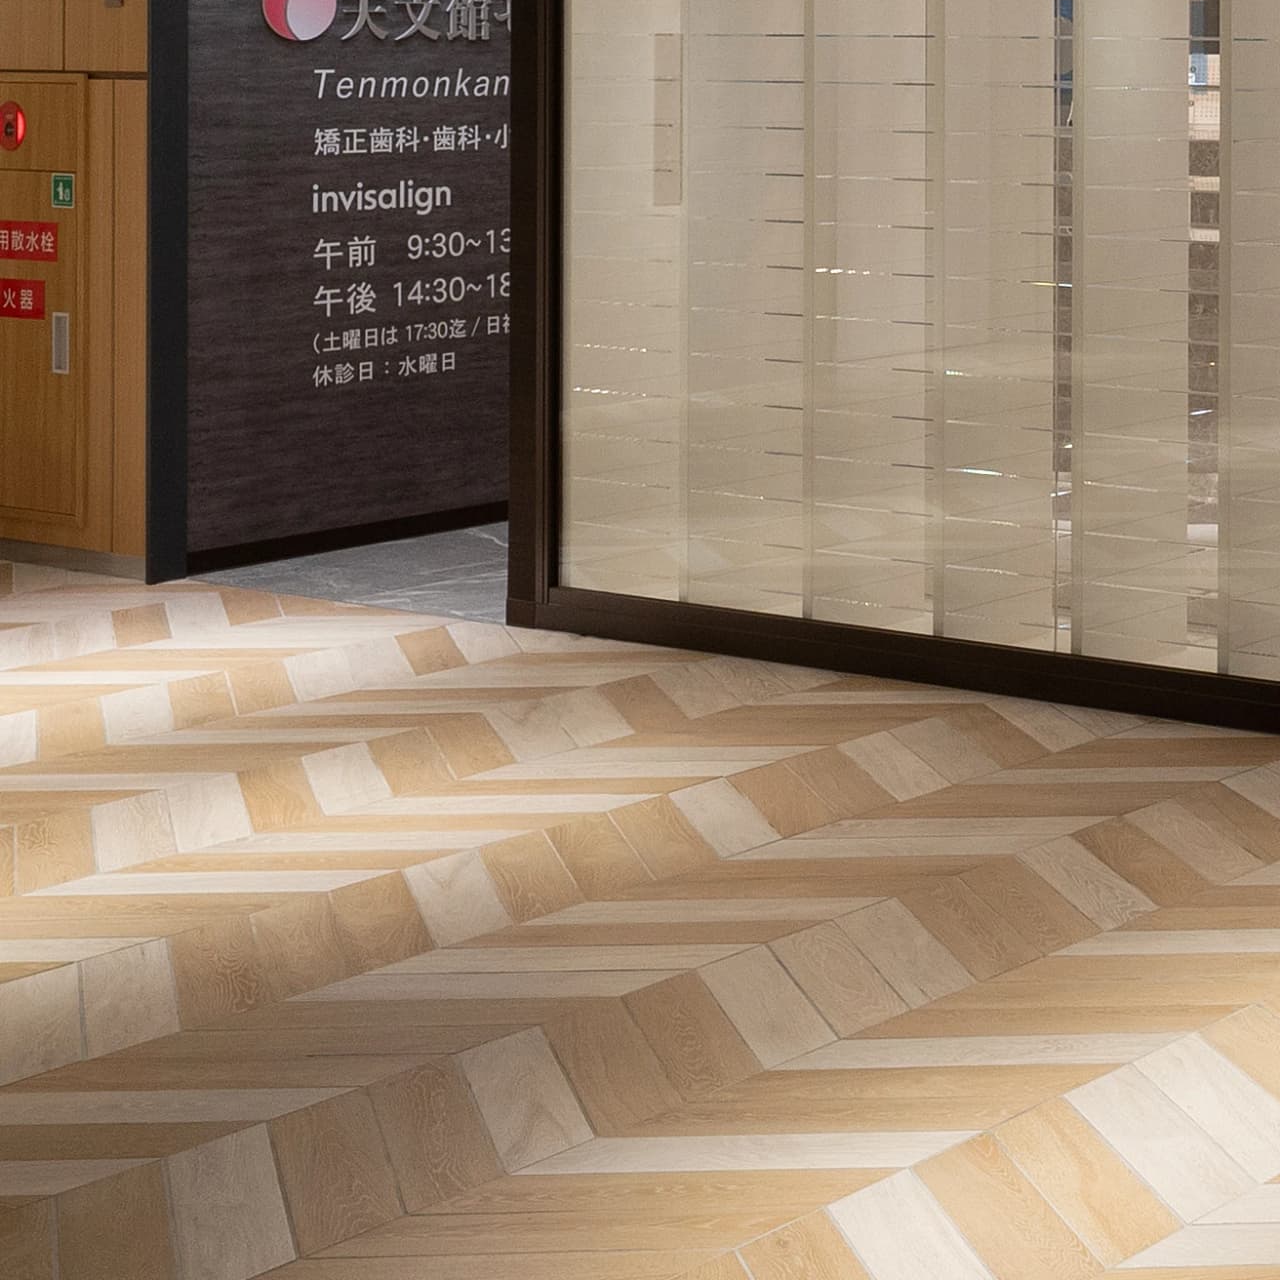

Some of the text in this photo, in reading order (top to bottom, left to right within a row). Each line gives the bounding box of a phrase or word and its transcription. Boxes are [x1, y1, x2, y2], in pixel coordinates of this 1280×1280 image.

[314, 68, 510, 99] Tenmonkan
[312, 179, 452, 215] invisalign
[0, 229, 55, 253] 用散水栓
[313, 235, 377, 270] 午前
[313, 281, 377, 317] 午後
